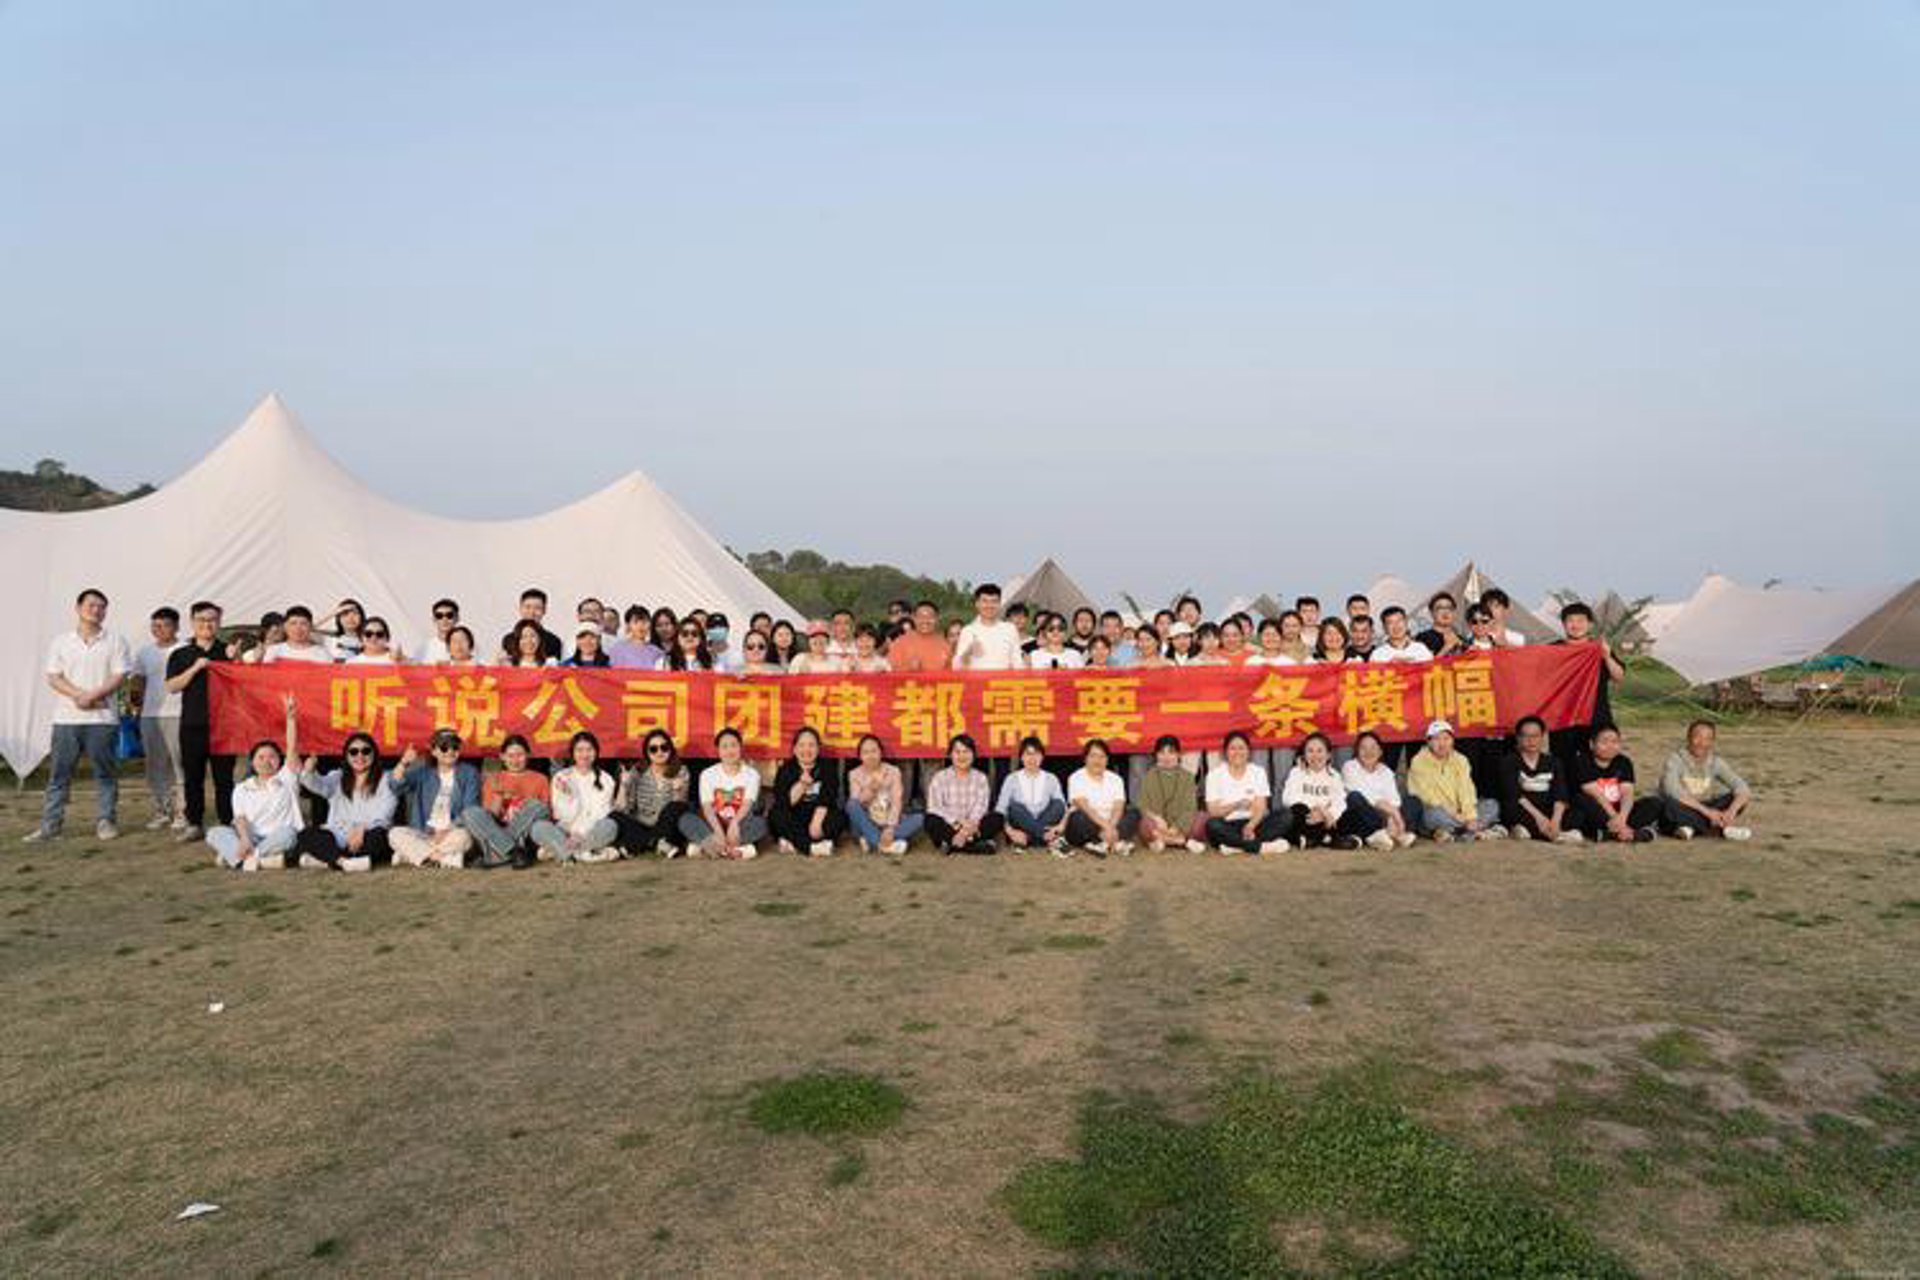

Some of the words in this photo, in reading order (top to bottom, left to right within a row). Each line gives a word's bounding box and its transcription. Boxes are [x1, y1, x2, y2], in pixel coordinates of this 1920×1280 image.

[330, 660, 1497, 749] 听说公司团建都需要一条横幅
